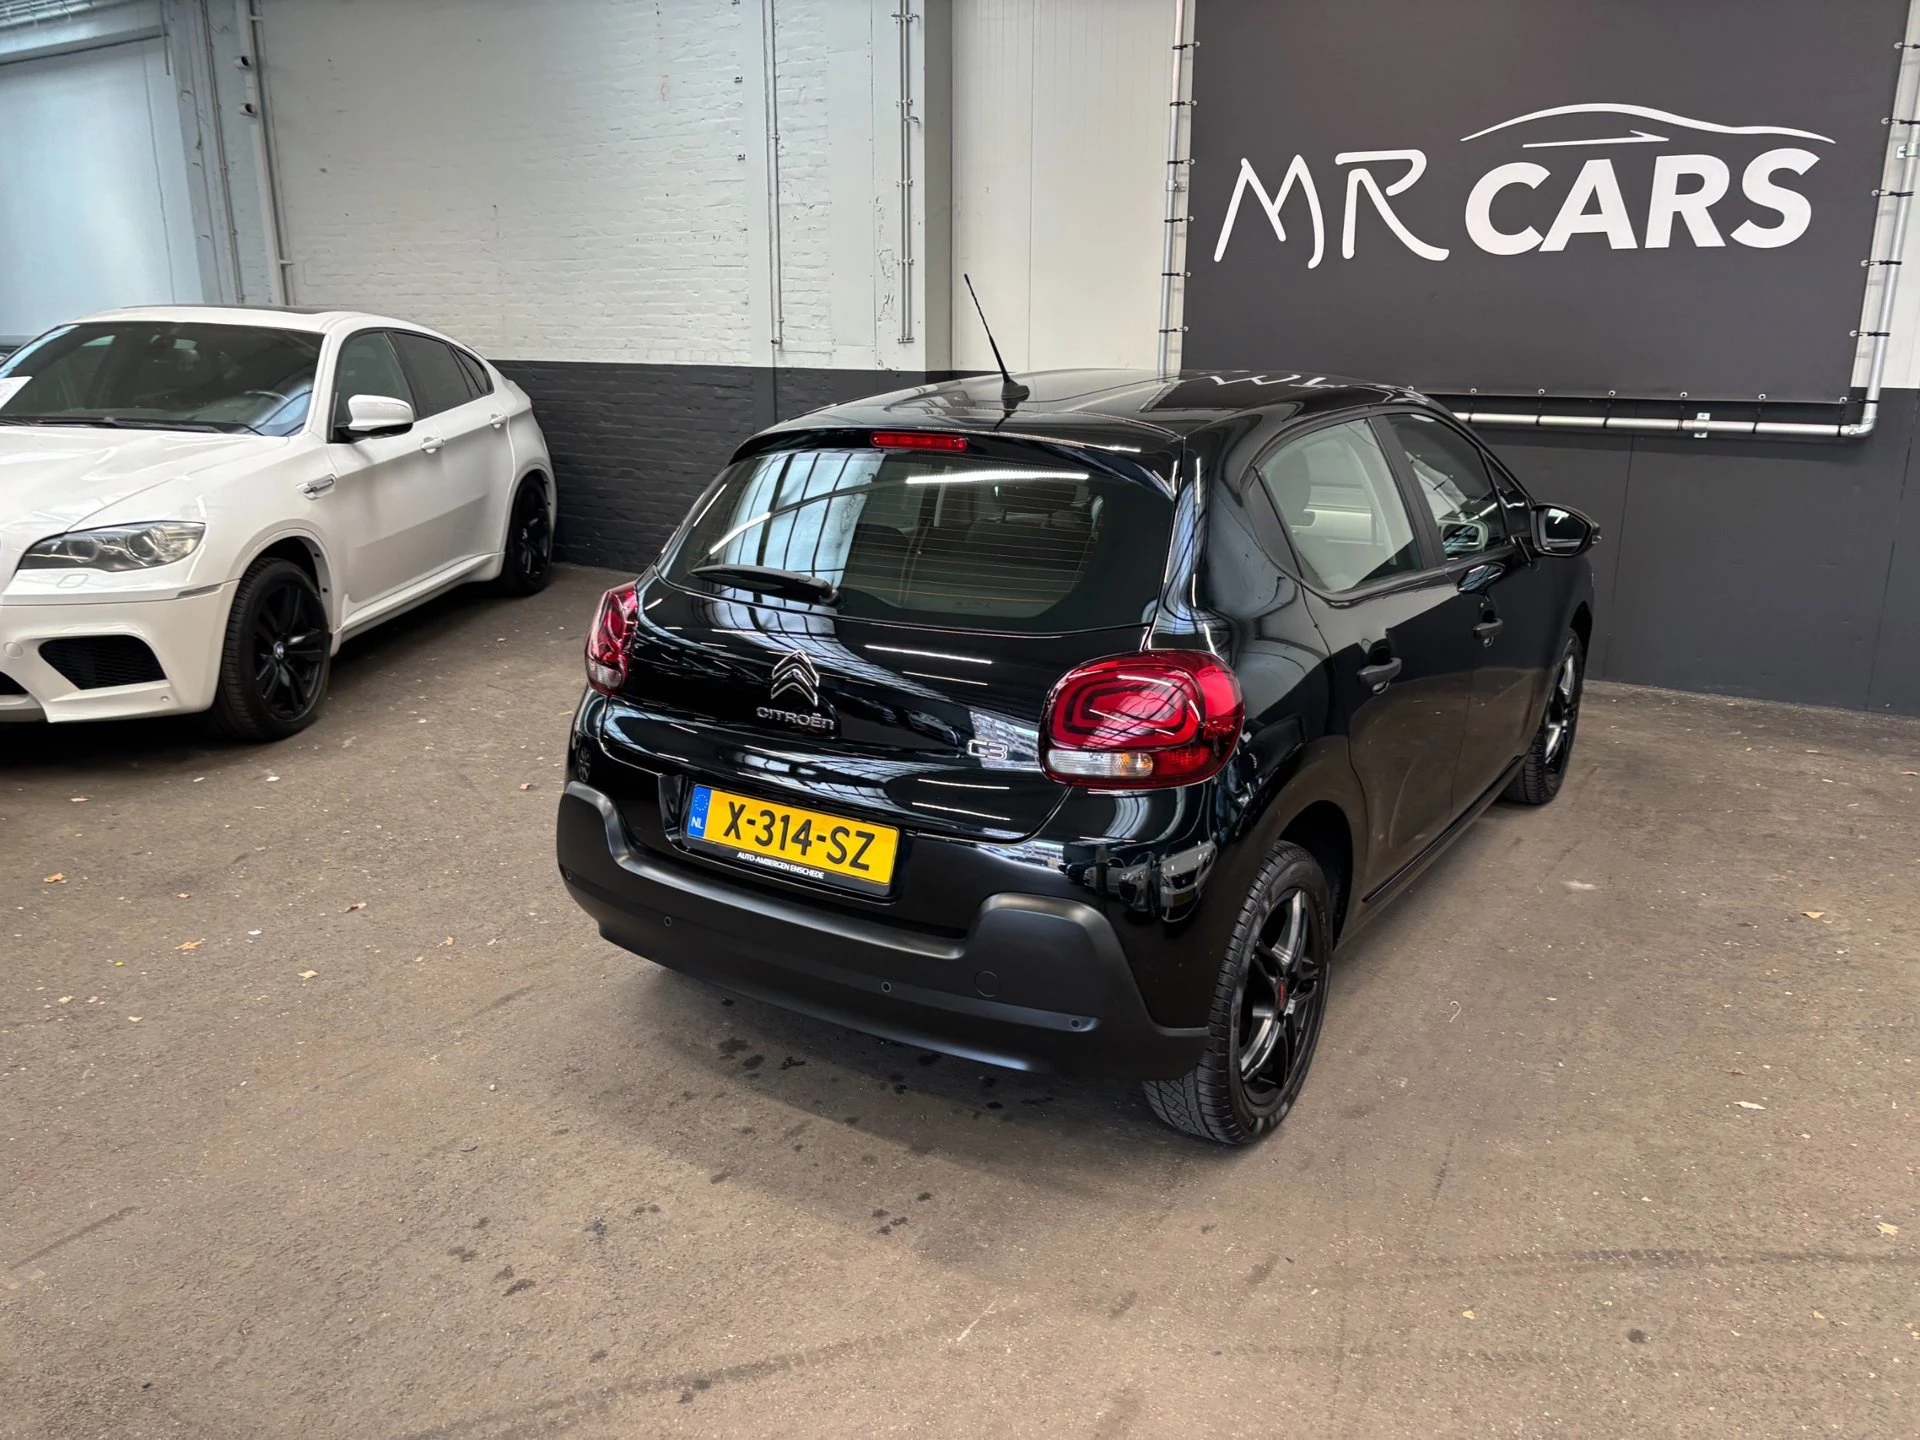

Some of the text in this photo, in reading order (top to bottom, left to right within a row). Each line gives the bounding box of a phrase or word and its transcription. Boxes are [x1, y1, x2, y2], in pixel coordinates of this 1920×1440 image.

[1214, 148, 1820, 269] MR CARS
[967, 739, 1008, 760] C3
[691, 816, 704, 829] NL
[723, 801, 875, 871] X-314-SZ
[790, 864, 824, 879] ENSCHEDE
